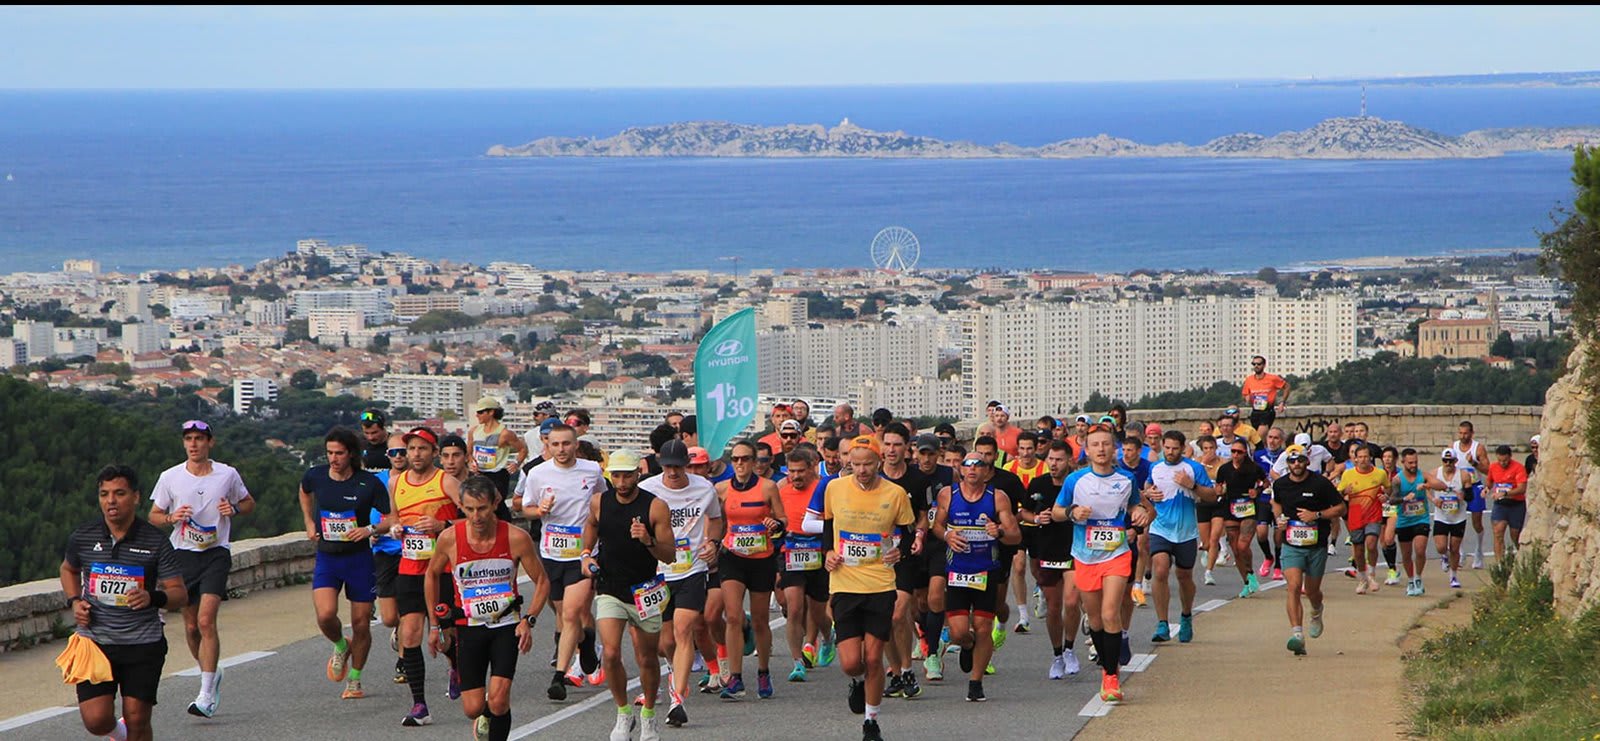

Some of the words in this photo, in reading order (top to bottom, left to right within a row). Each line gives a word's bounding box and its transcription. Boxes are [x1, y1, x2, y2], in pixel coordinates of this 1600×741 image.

[708, 355, 749, 367] HYUNDAI
[670, 507, 701, 518] RSEILLE
[329, 523, 347, 533] 1666
[188, 530, 204, 543] 1155
[1093, 530, 1113, 541] 753
[1293, 530, 1308, 539] 1086
[405, 539, 424, 550] 953
[552, 537, 568, 548] 1231
[736, 536, 755, 547] 2022
[794, 552, 810, 562] 1178
[847, 545, 867, 558] 1565
[459, 565, 512, 578] Martigues
[956, 573, 976, 582] 814
[100, 580, 127, 595] 6727
[643, 590, 663, 607] 993
[475, 600, 499, 615] 1360
